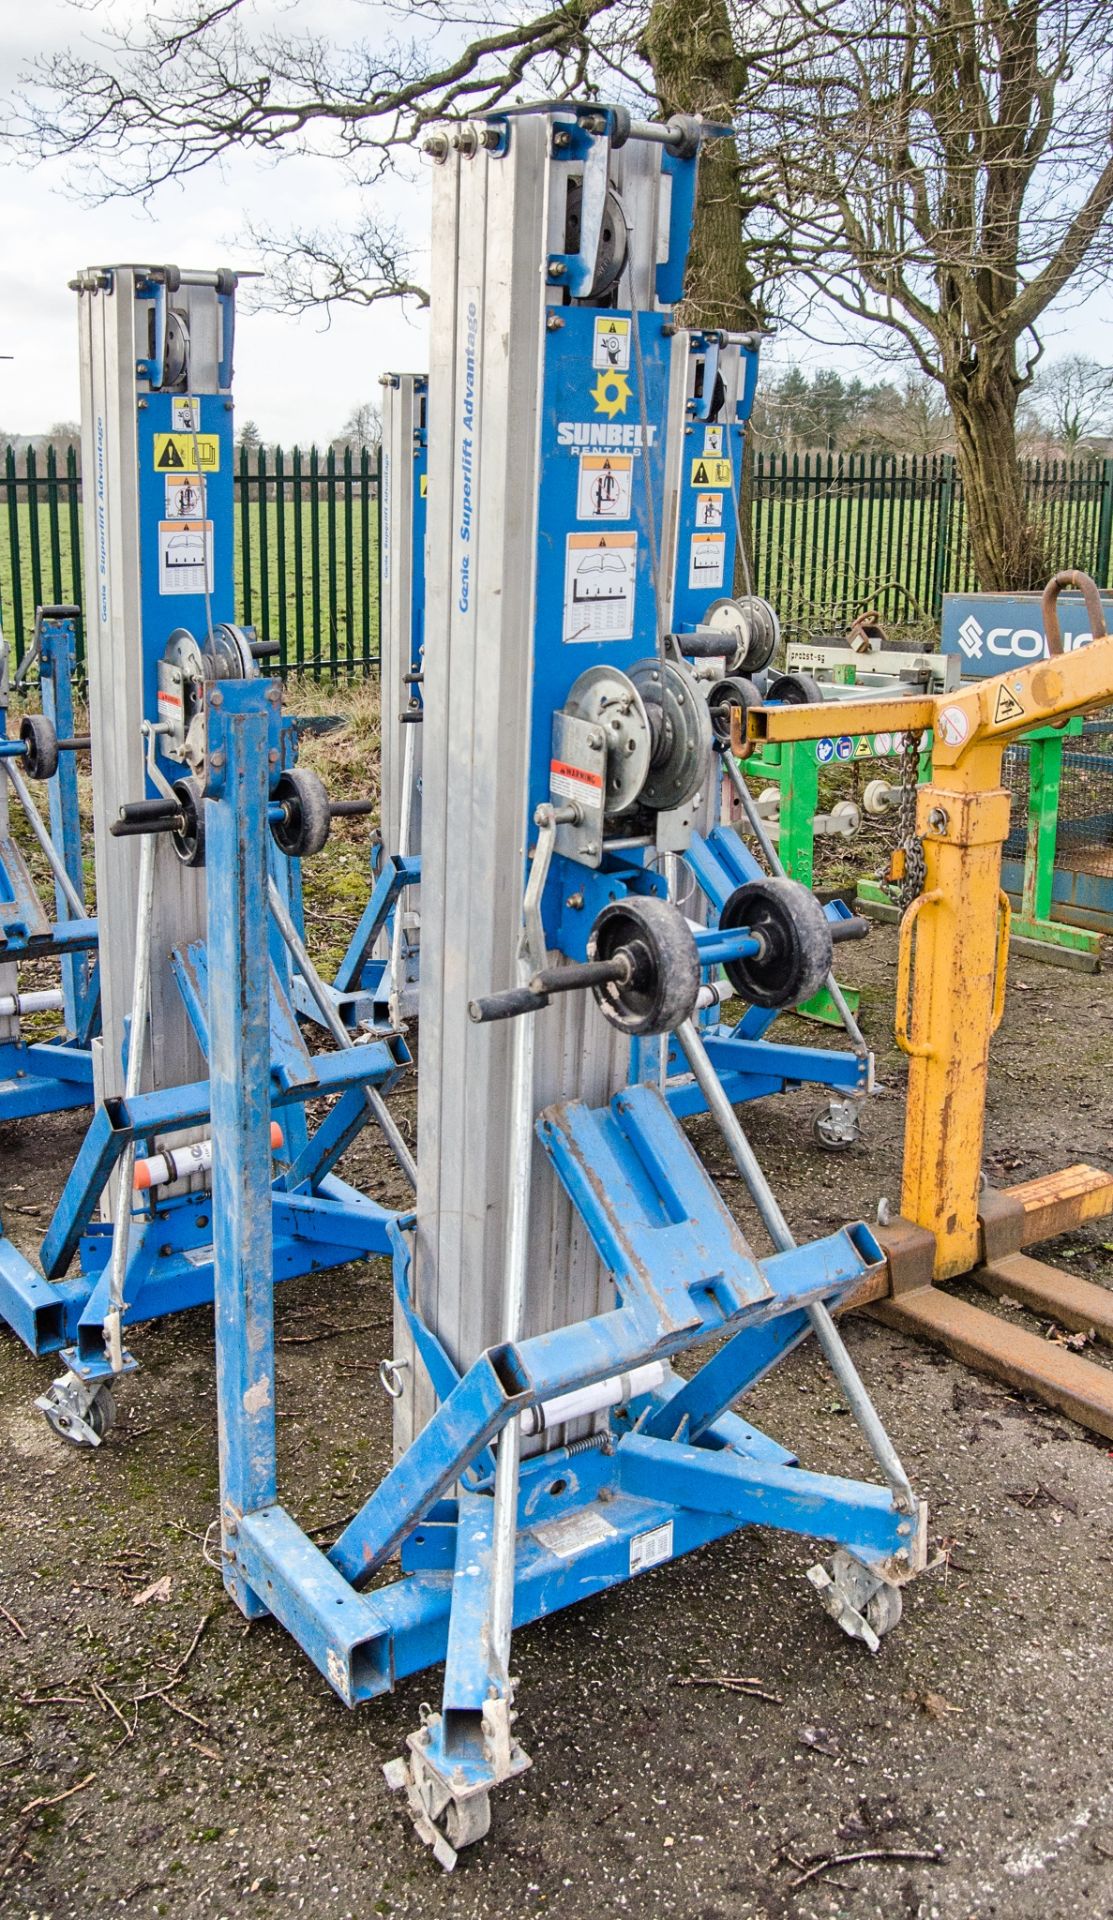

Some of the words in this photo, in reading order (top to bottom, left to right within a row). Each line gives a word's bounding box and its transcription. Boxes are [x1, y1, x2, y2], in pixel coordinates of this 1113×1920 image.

[463, 301, 477, 431] Advantage
[97, 416, 105, 501] Advantage
[557, 422, 657, 446] SUNBELT
[571, 446, 642, 456] RENTALS
[460, 438, 474, 542] Superlift
[98, 506, 106, 576] Superlift
[459, 555, 470, 613] Genie
